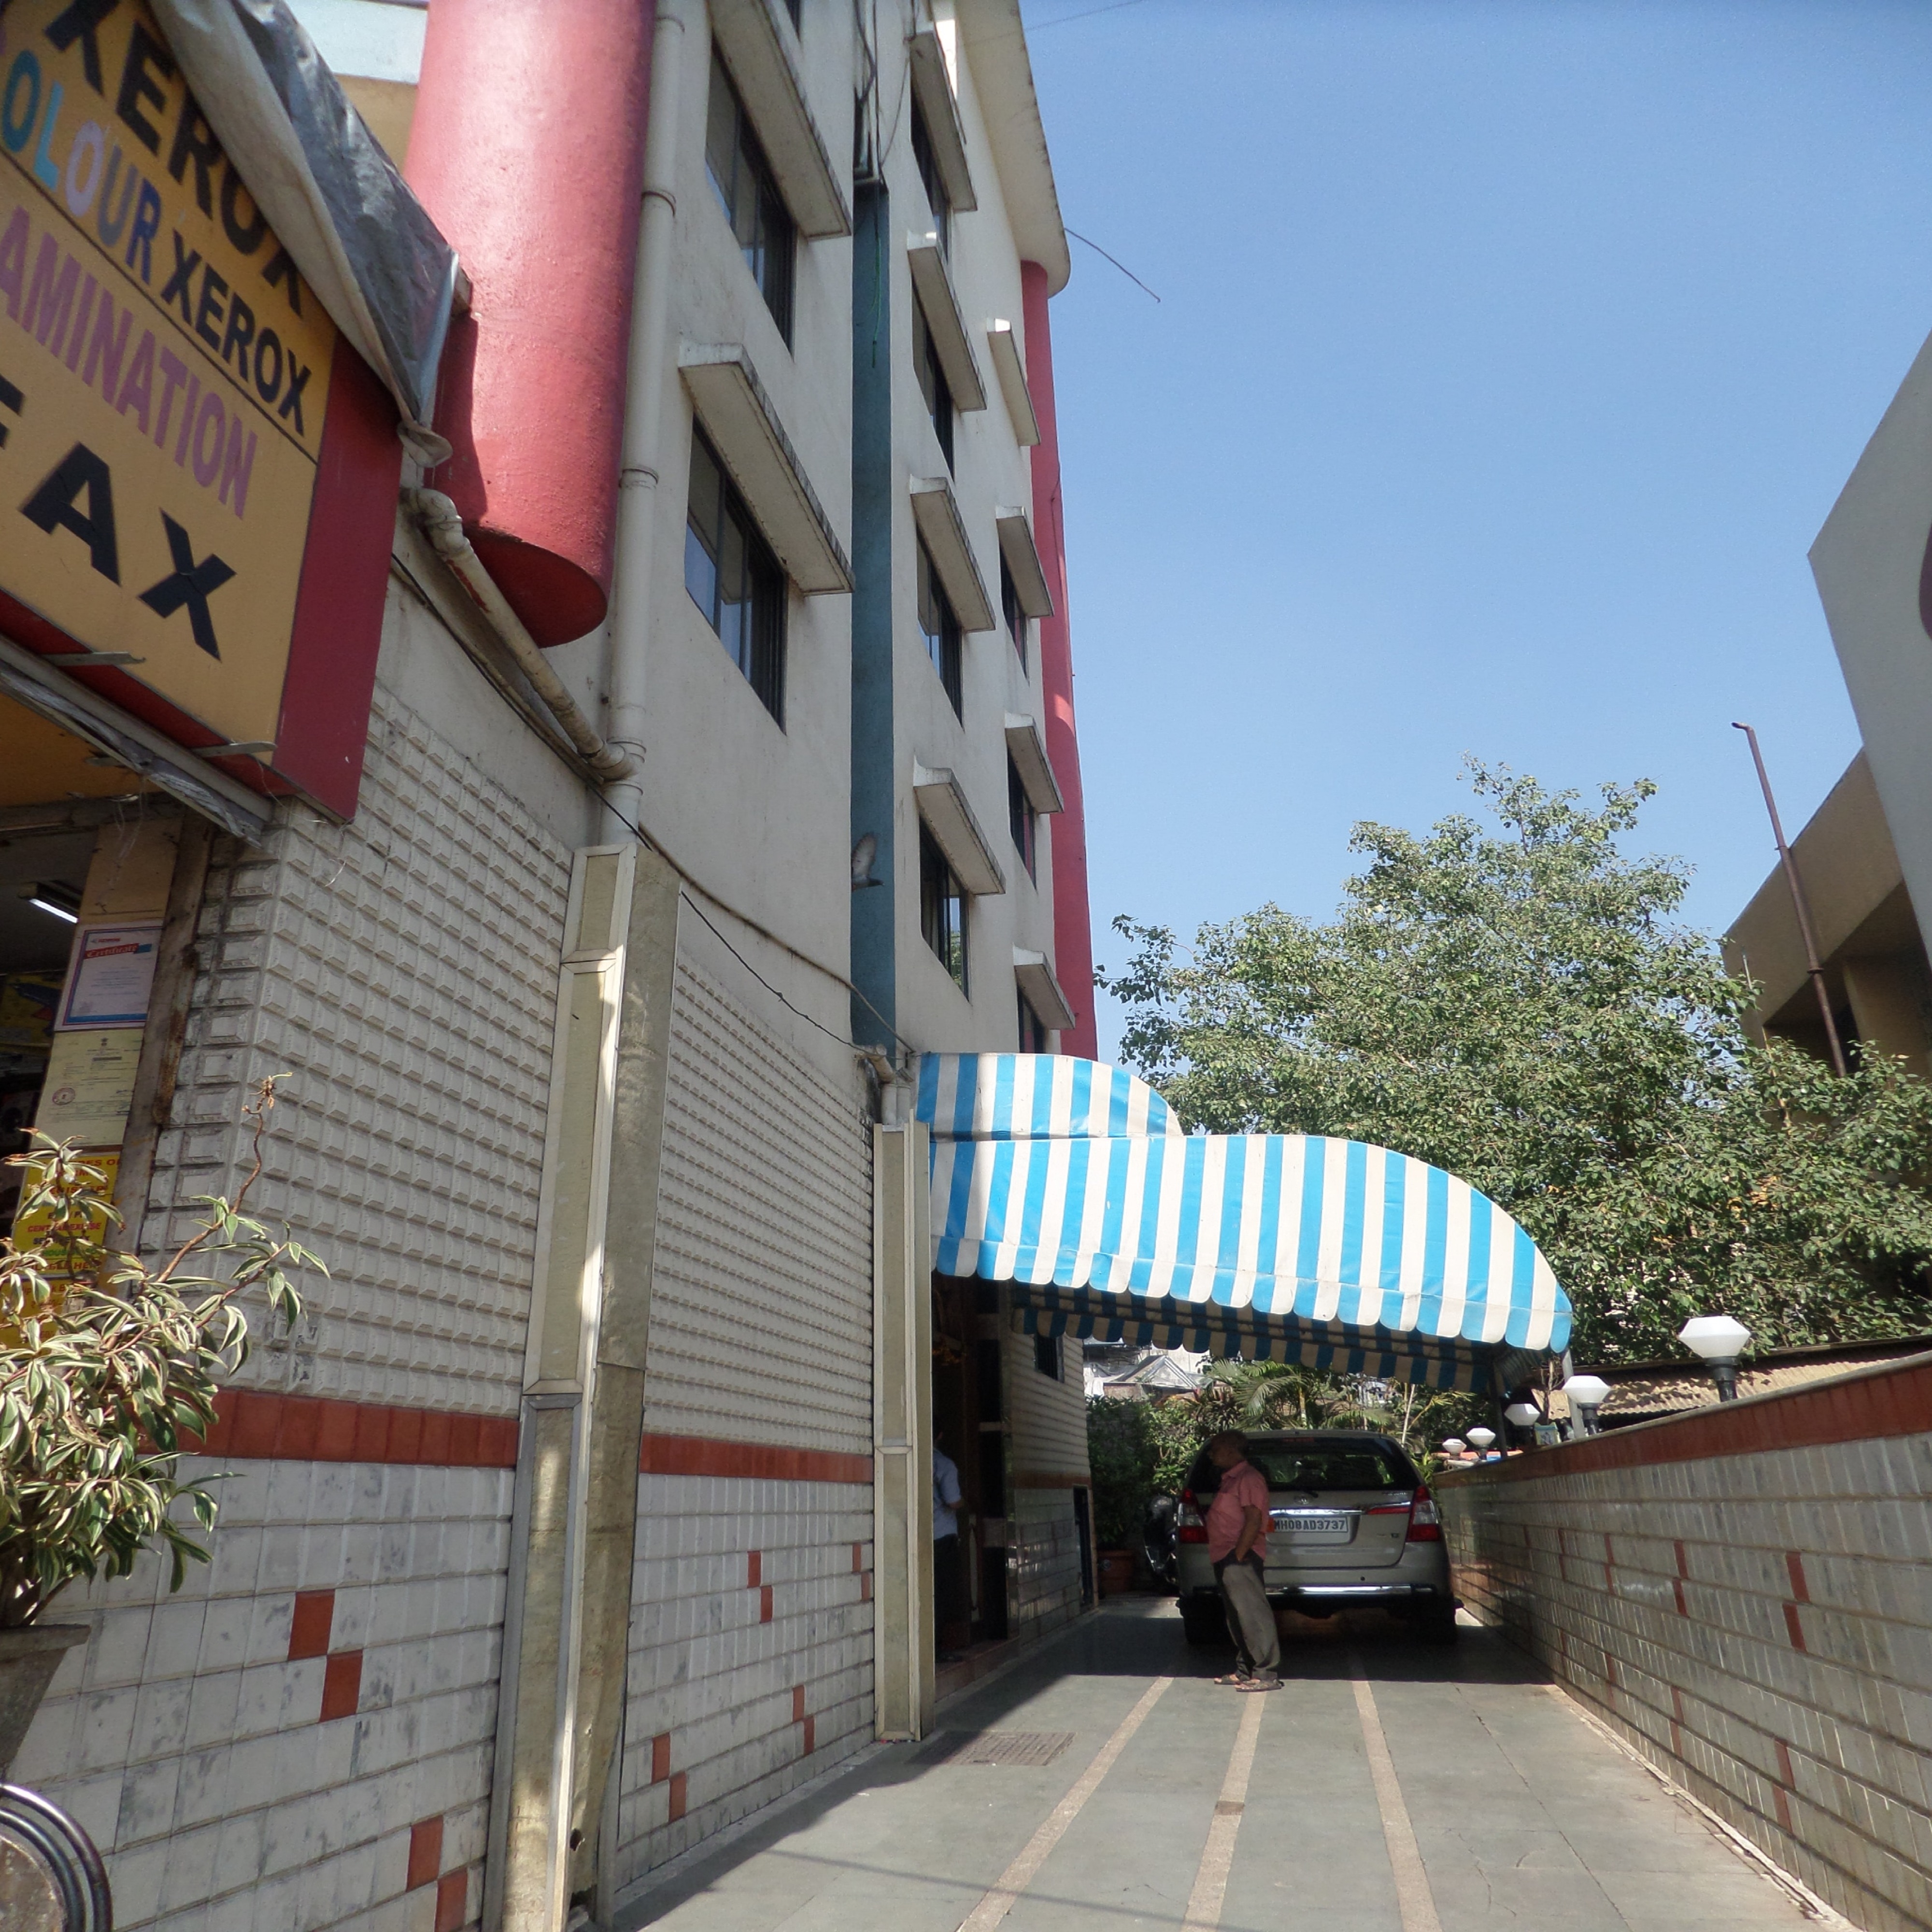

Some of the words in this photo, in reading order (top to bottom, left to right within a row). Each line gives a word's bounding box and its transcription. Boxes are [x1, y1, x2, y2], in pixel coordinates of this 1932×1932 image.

[0, 27, 162, 285] OLOUR
[160, 227, 312, 439] XEROX
[1274, 1520, 1345, 1531] MH08AD3737
